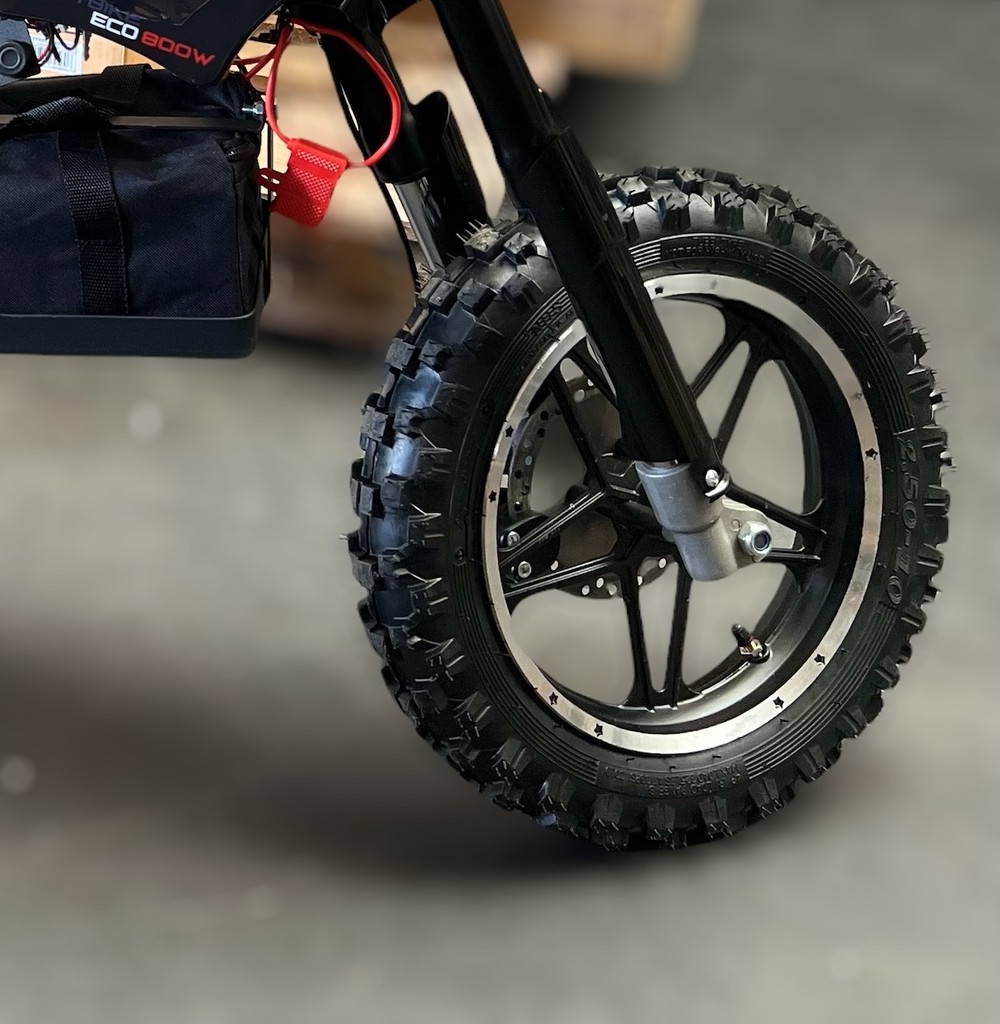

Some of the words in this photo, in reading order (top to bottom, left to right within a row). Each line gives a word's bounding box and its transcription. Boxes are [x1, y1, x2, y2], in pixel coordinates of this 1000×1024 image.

[89, 10, 140, 41] ECO
[140, 30, 216, 67] 800W
[886, 436, 920, 606] 2.50-10
